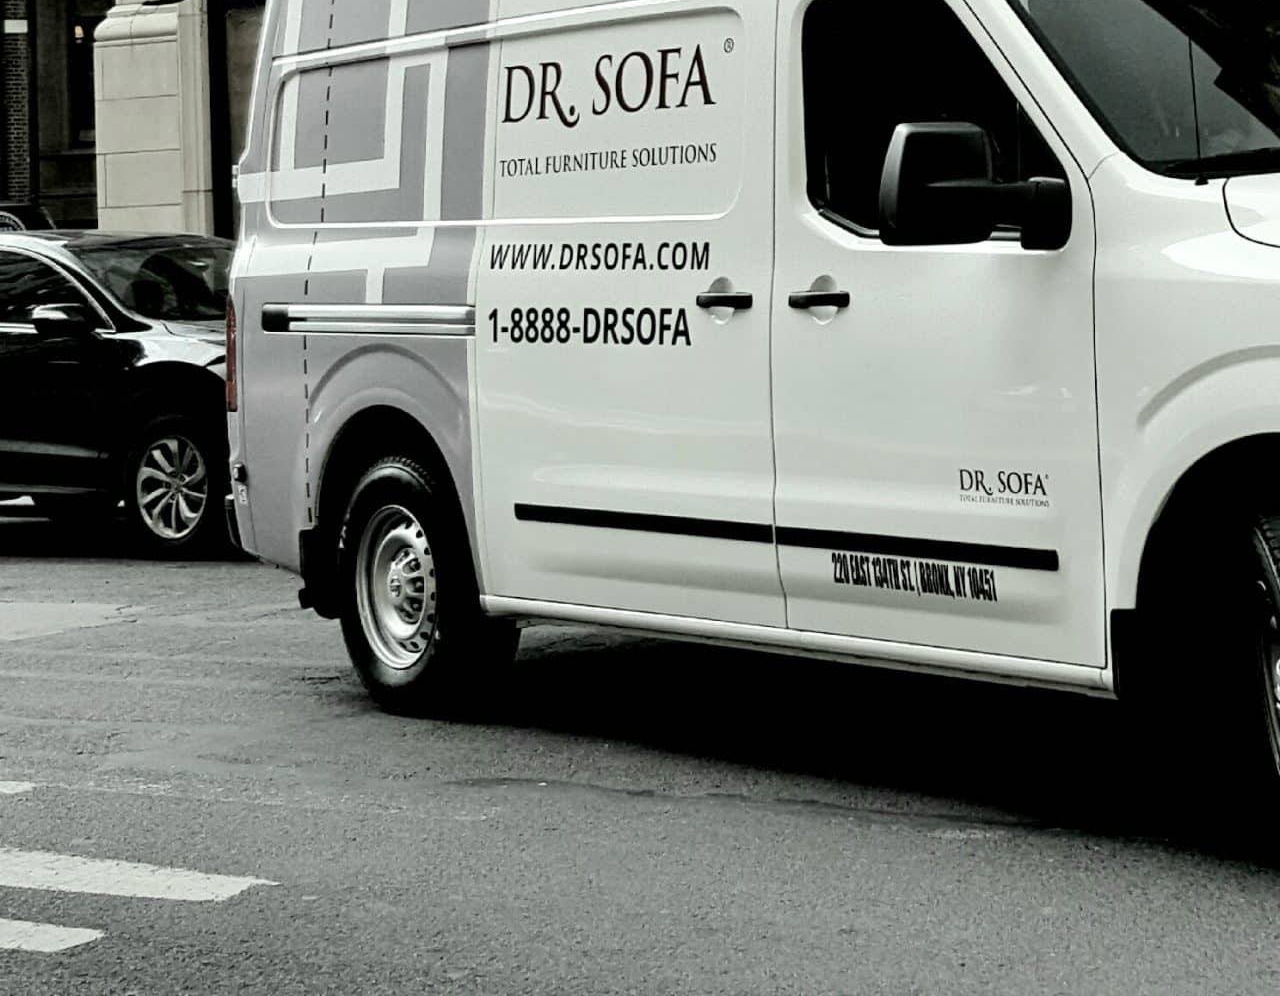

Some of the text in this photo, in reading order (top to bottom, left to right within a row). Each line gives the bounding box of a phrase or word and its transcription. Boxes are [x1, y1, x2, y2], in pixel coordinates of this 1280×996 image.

[502, 62, 580, 128] DR.
[592, 44, 717, 115] SOFA
[499, 142, 717, 178] TOTAL FURNITURE SOLUTIONS
[489, 241, 711, 271] WWW.DRSOFA.COM
[488, 306, 692, 347] 1-8888-DRSOFA
[959, 468, 1047, 496] DR. SOFA
[832, 552, 850, 584] 220
[850, 554, 872, 586] EAST
[872, 557, 900, 590] 134TH
[919, 562, 956, 600] BRONX,
[953, 565, 968, 598] NY
[968, 566, 998, 602] 10451
